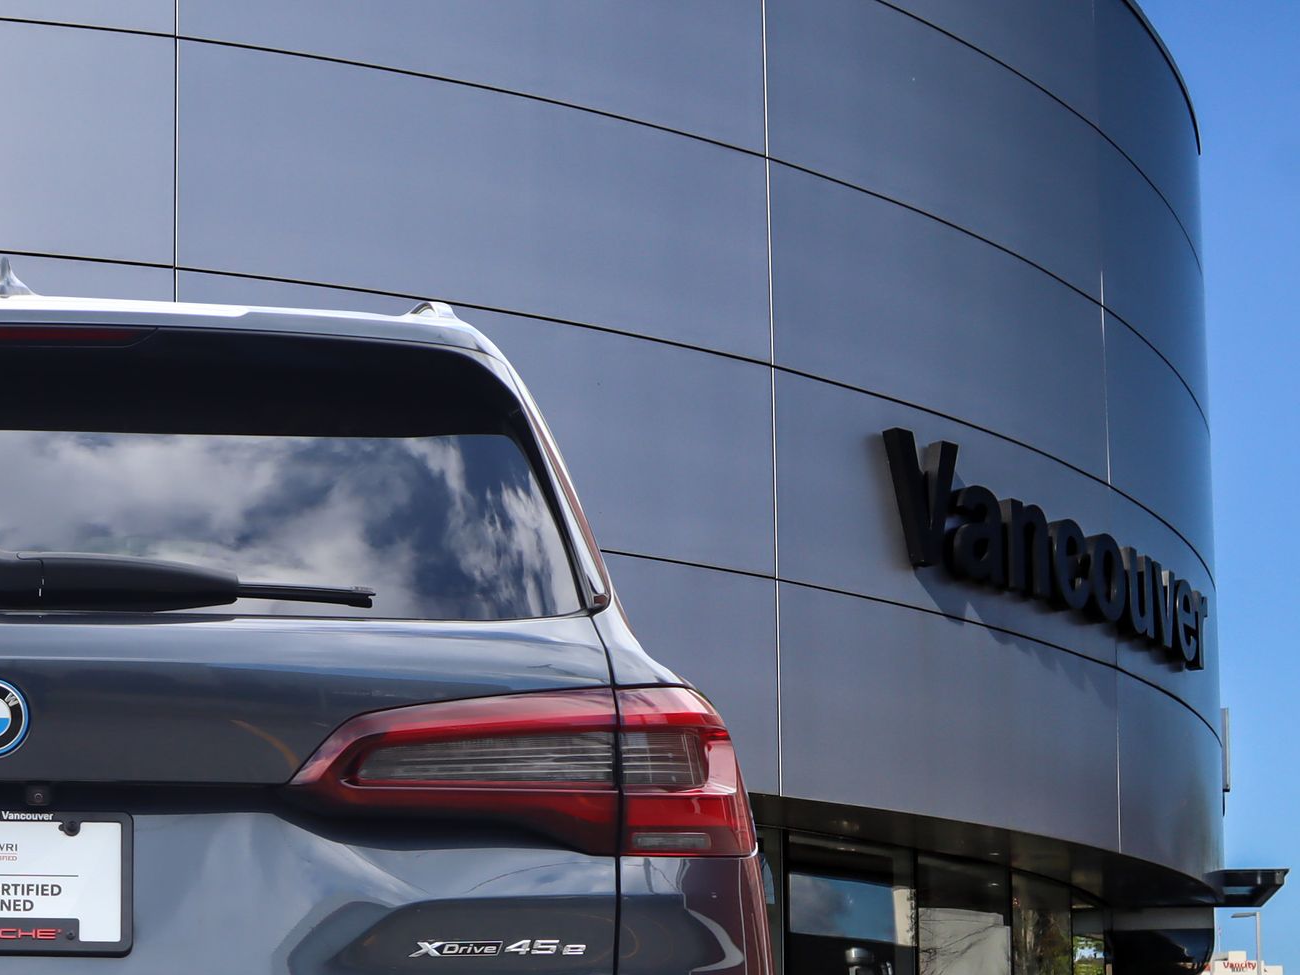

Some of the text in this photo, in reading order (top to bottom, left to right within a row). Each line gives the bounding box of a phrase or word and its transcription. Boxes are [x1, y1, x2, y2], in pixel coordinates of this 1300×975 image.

[882, 427, 1207, 670] Vancouver
[1, 811, 54, 821] Vancouver
[1222, 961, 1257, 970] Vancity
